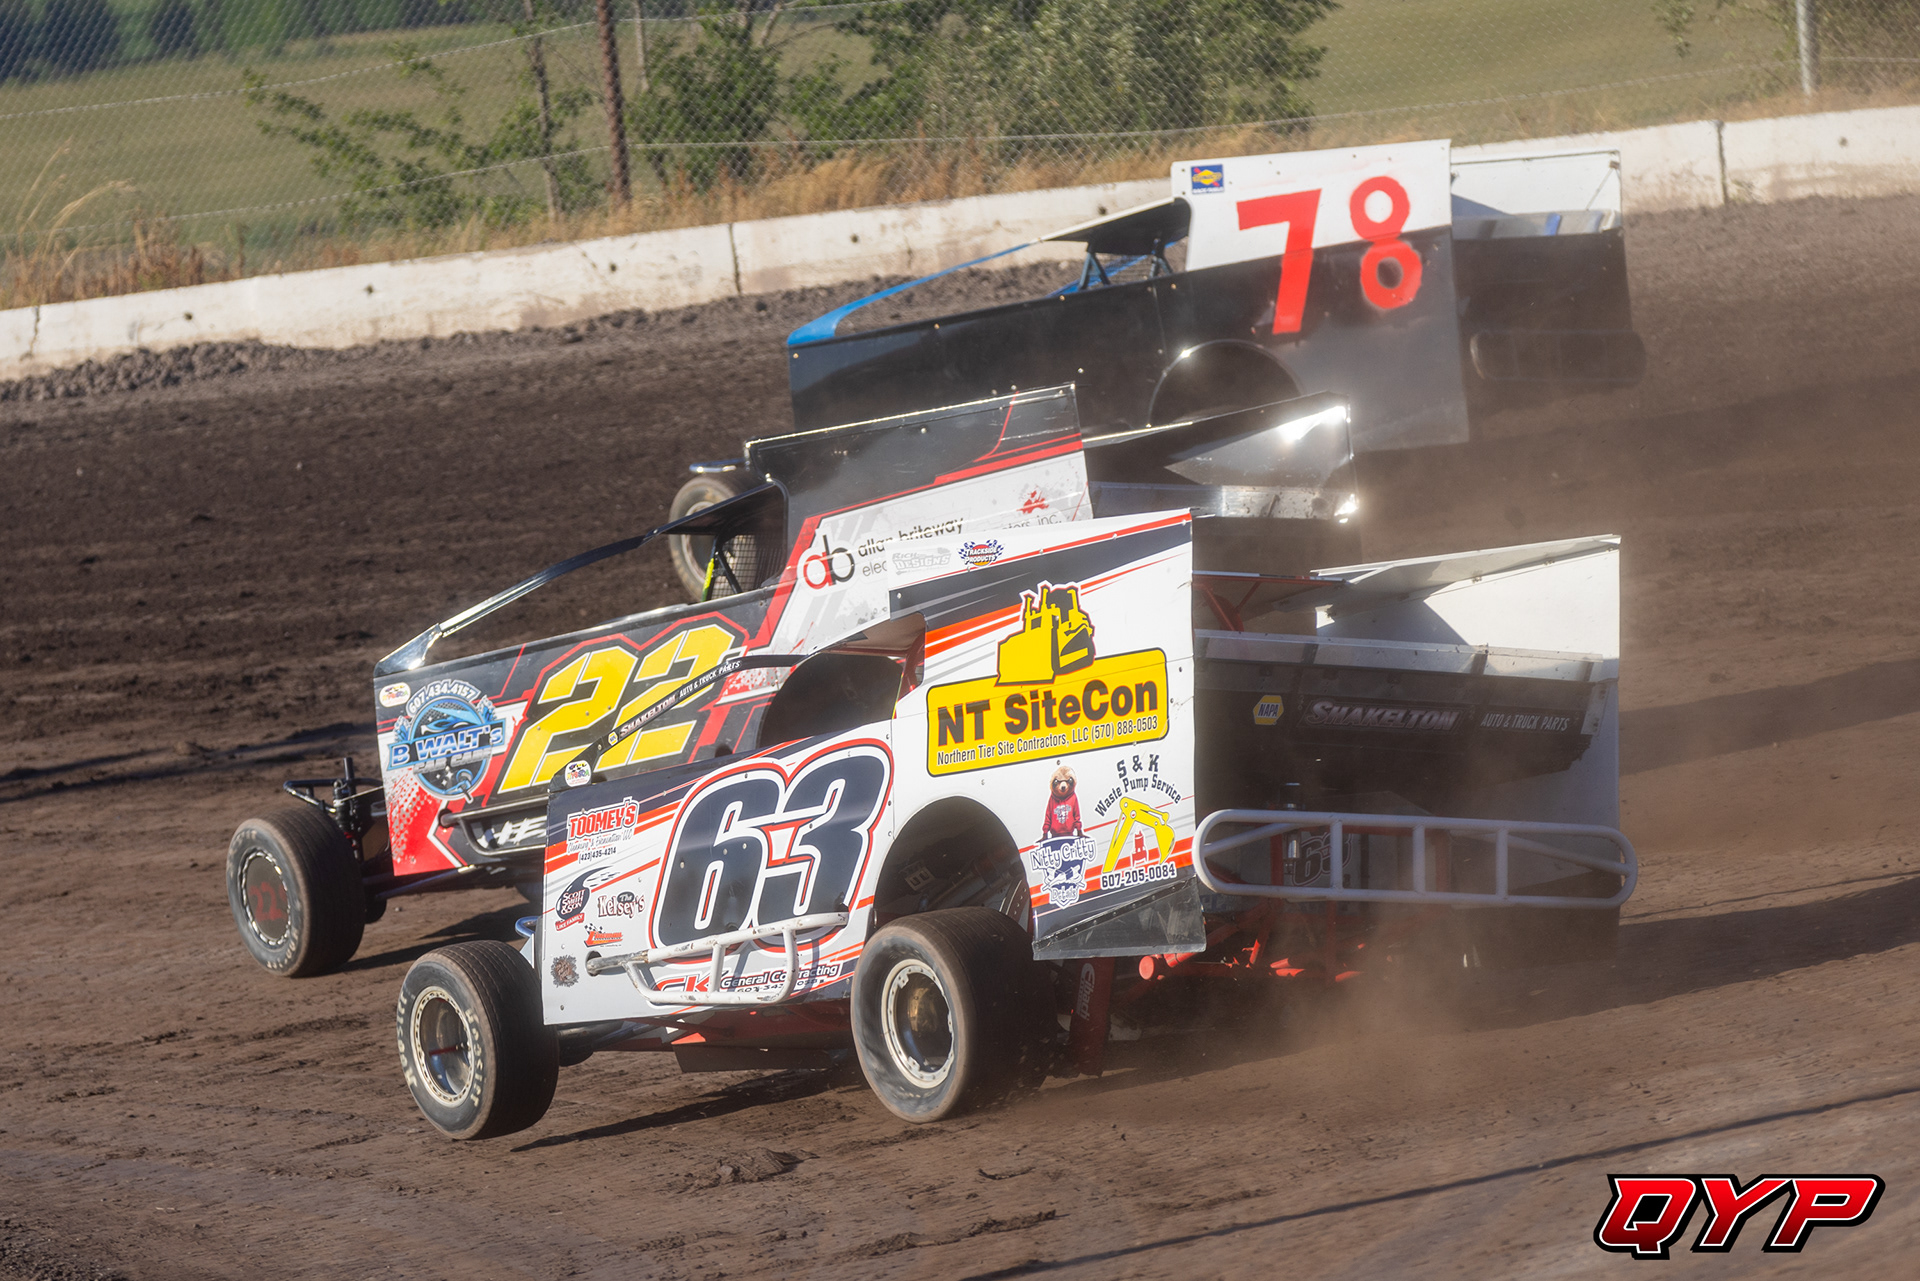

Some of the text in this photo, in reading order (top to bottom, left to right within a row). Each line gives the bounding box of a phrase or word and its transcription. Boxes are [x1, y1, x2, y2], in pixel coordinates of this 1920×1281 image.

[1236, 176, 1423, 334] 78
[964, 555, 997, 565] PRODUCTS
[965, 547, 998, 556] TRACKSIDE
[409, 682, 477, 714] 607.434.4157
[497, 623, 737, 795] 22
[620, 694, 677, 737] SHAKELTON
[679, 685, 693, 698] AUTO
[699, 672, 717, 687] TRUCK
[718, 660, 741, 675] PARTS
[938, 679, 1159, 747] NT SiteCon
[1257, 703, 1279, 718] NAPA
[1305, 701, 1462, 731] SHAKELTON
[1480, 712, 1570, 732] AUTO & TRUCK PARTS
[391, 743, 410, 767] B
[937, 716, 1158, 766] Northern Tier Site Contractors, LLC (570) 888-0503
[1116, 754, 1160, 779] S & K
[1094, 786, 1123, 817] Waste
[1122, 777, 1149, 793] Pump
[1151, 773, 1182, 804] Service
[569, 801, 637, 838] TOOMEY'S
[652, 742, 892, 958] 63
[1030, 838, 1096, 870] Nitty Gritty
[1101, 864, 1177, 889] 607-205-0084
[562, 889, 586, 901] SCOTT
[598, 894, 645, 919] Kelsey's
[722, 963, 839, 989] General Coracting
